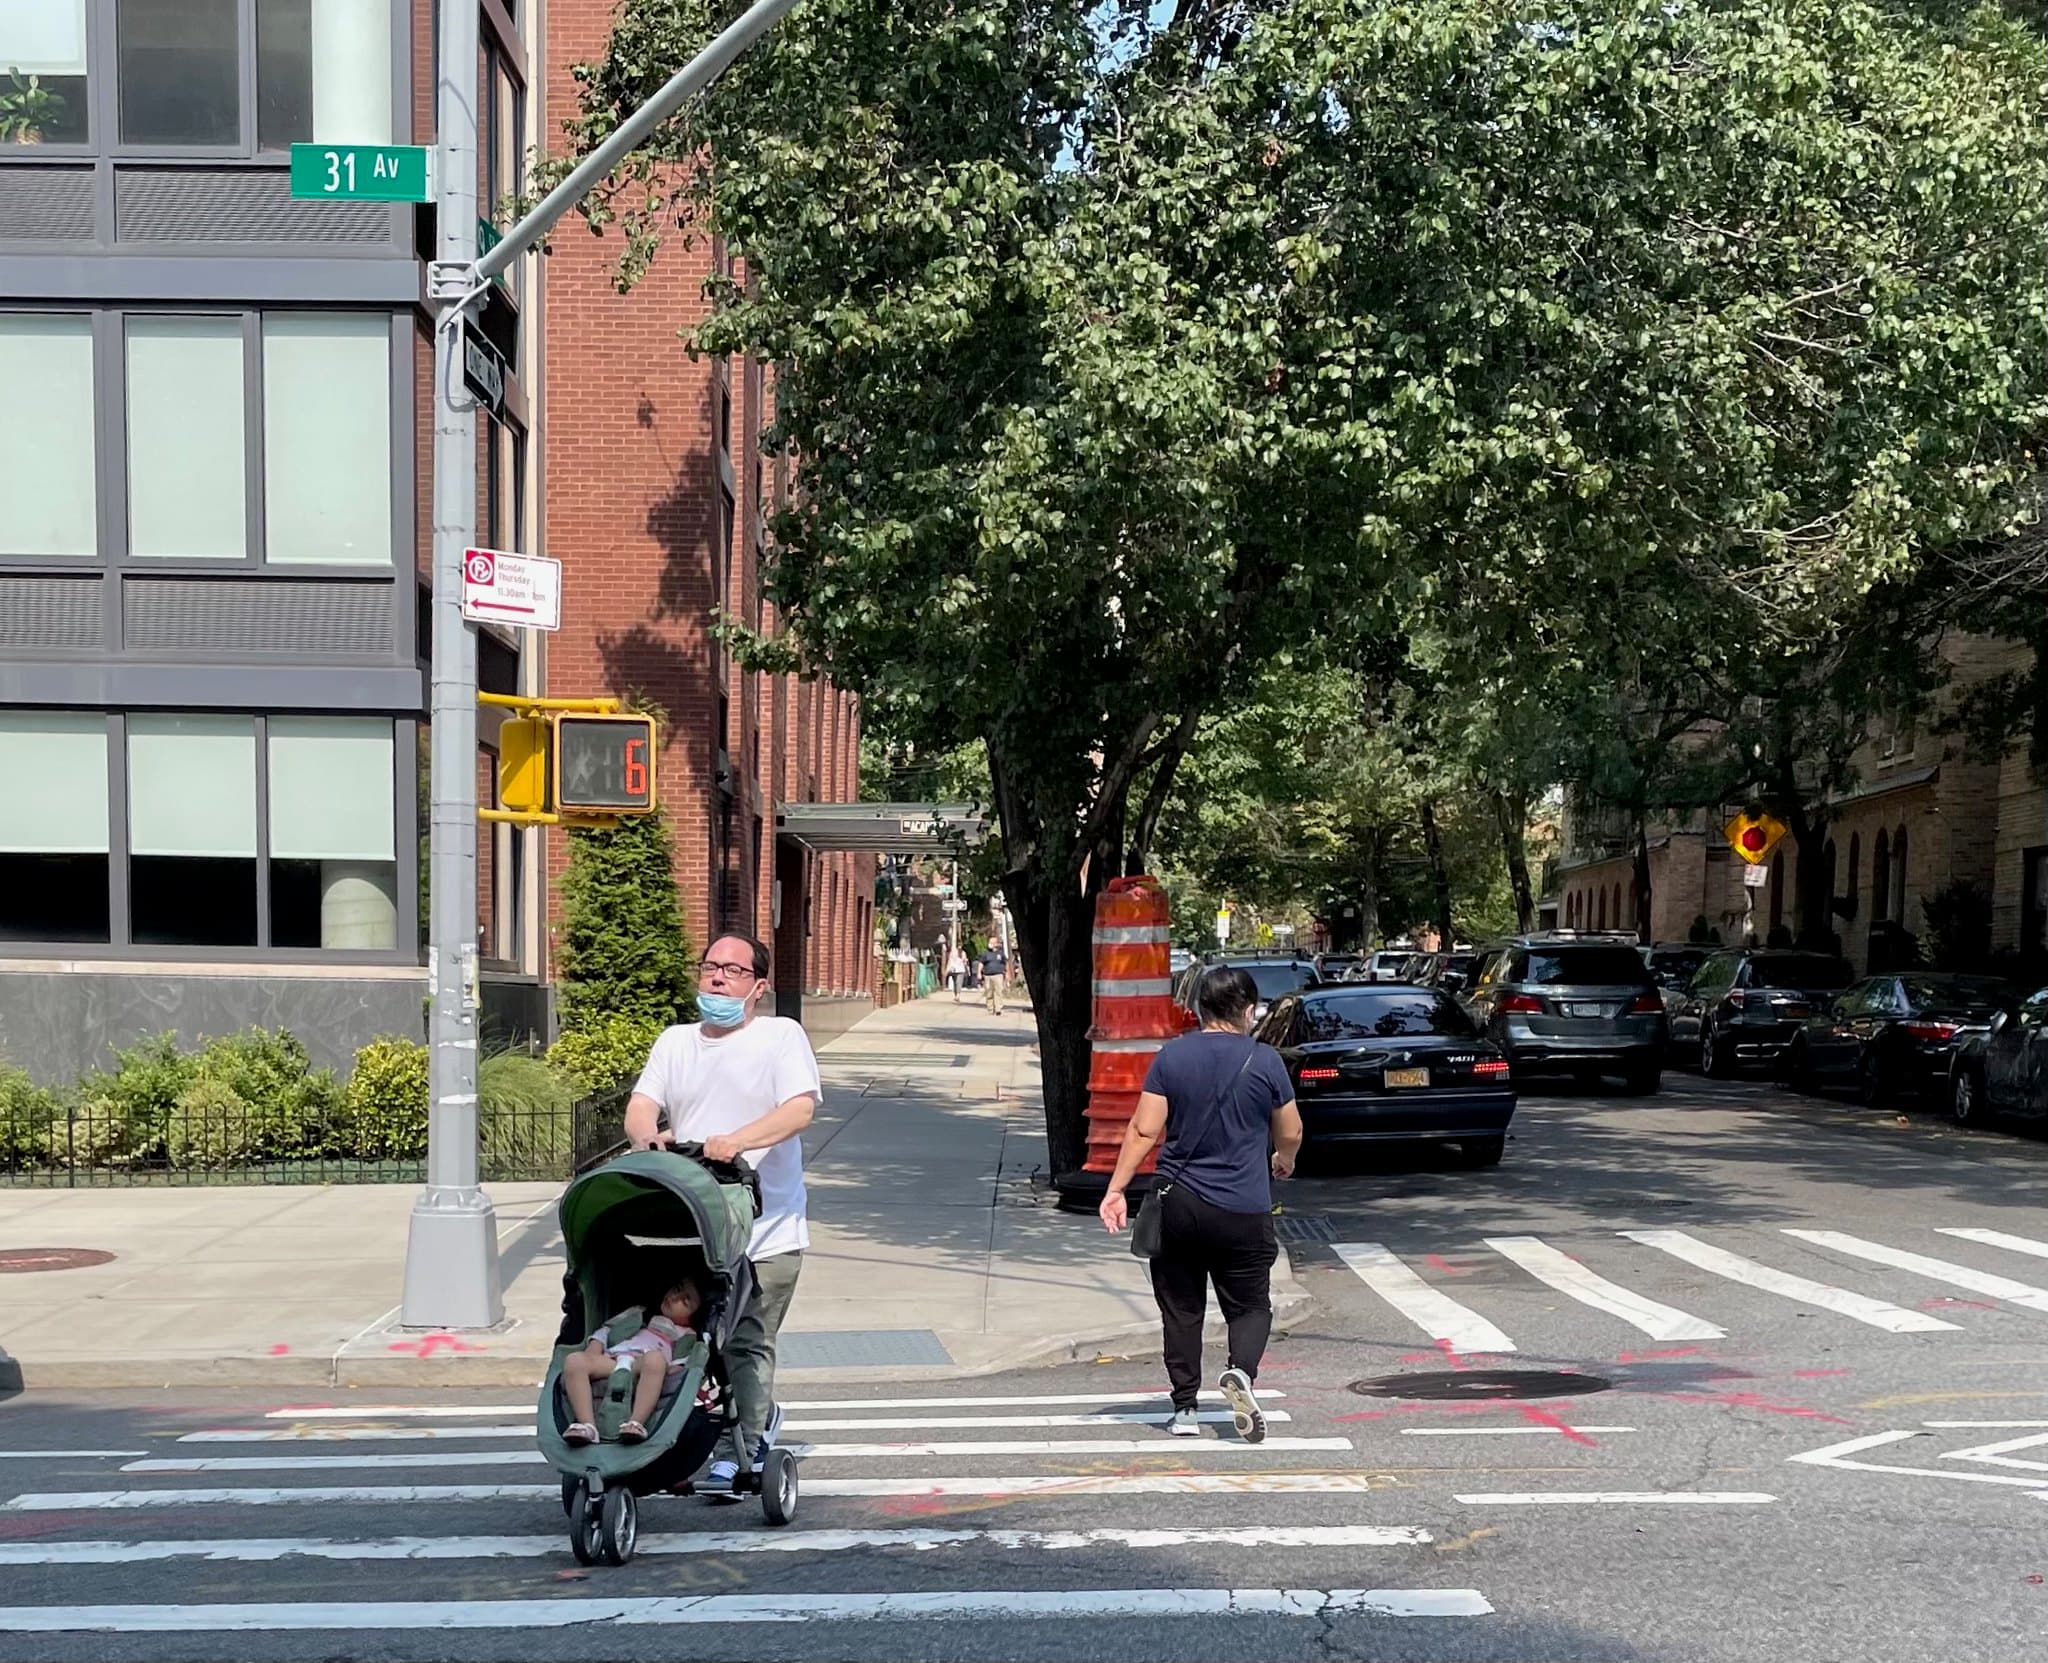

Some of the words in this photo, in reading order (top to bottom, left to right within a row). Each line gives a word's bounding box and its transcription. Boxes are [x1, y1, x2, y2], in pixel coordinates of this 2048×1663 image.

[323, 151, 355, 192] 31
[373, 153, 399, 178] Av
[498, 561, 526, 573] Monday
[498, 572, 531, 586] Thursday
[625, 738, 647, 795] 6
